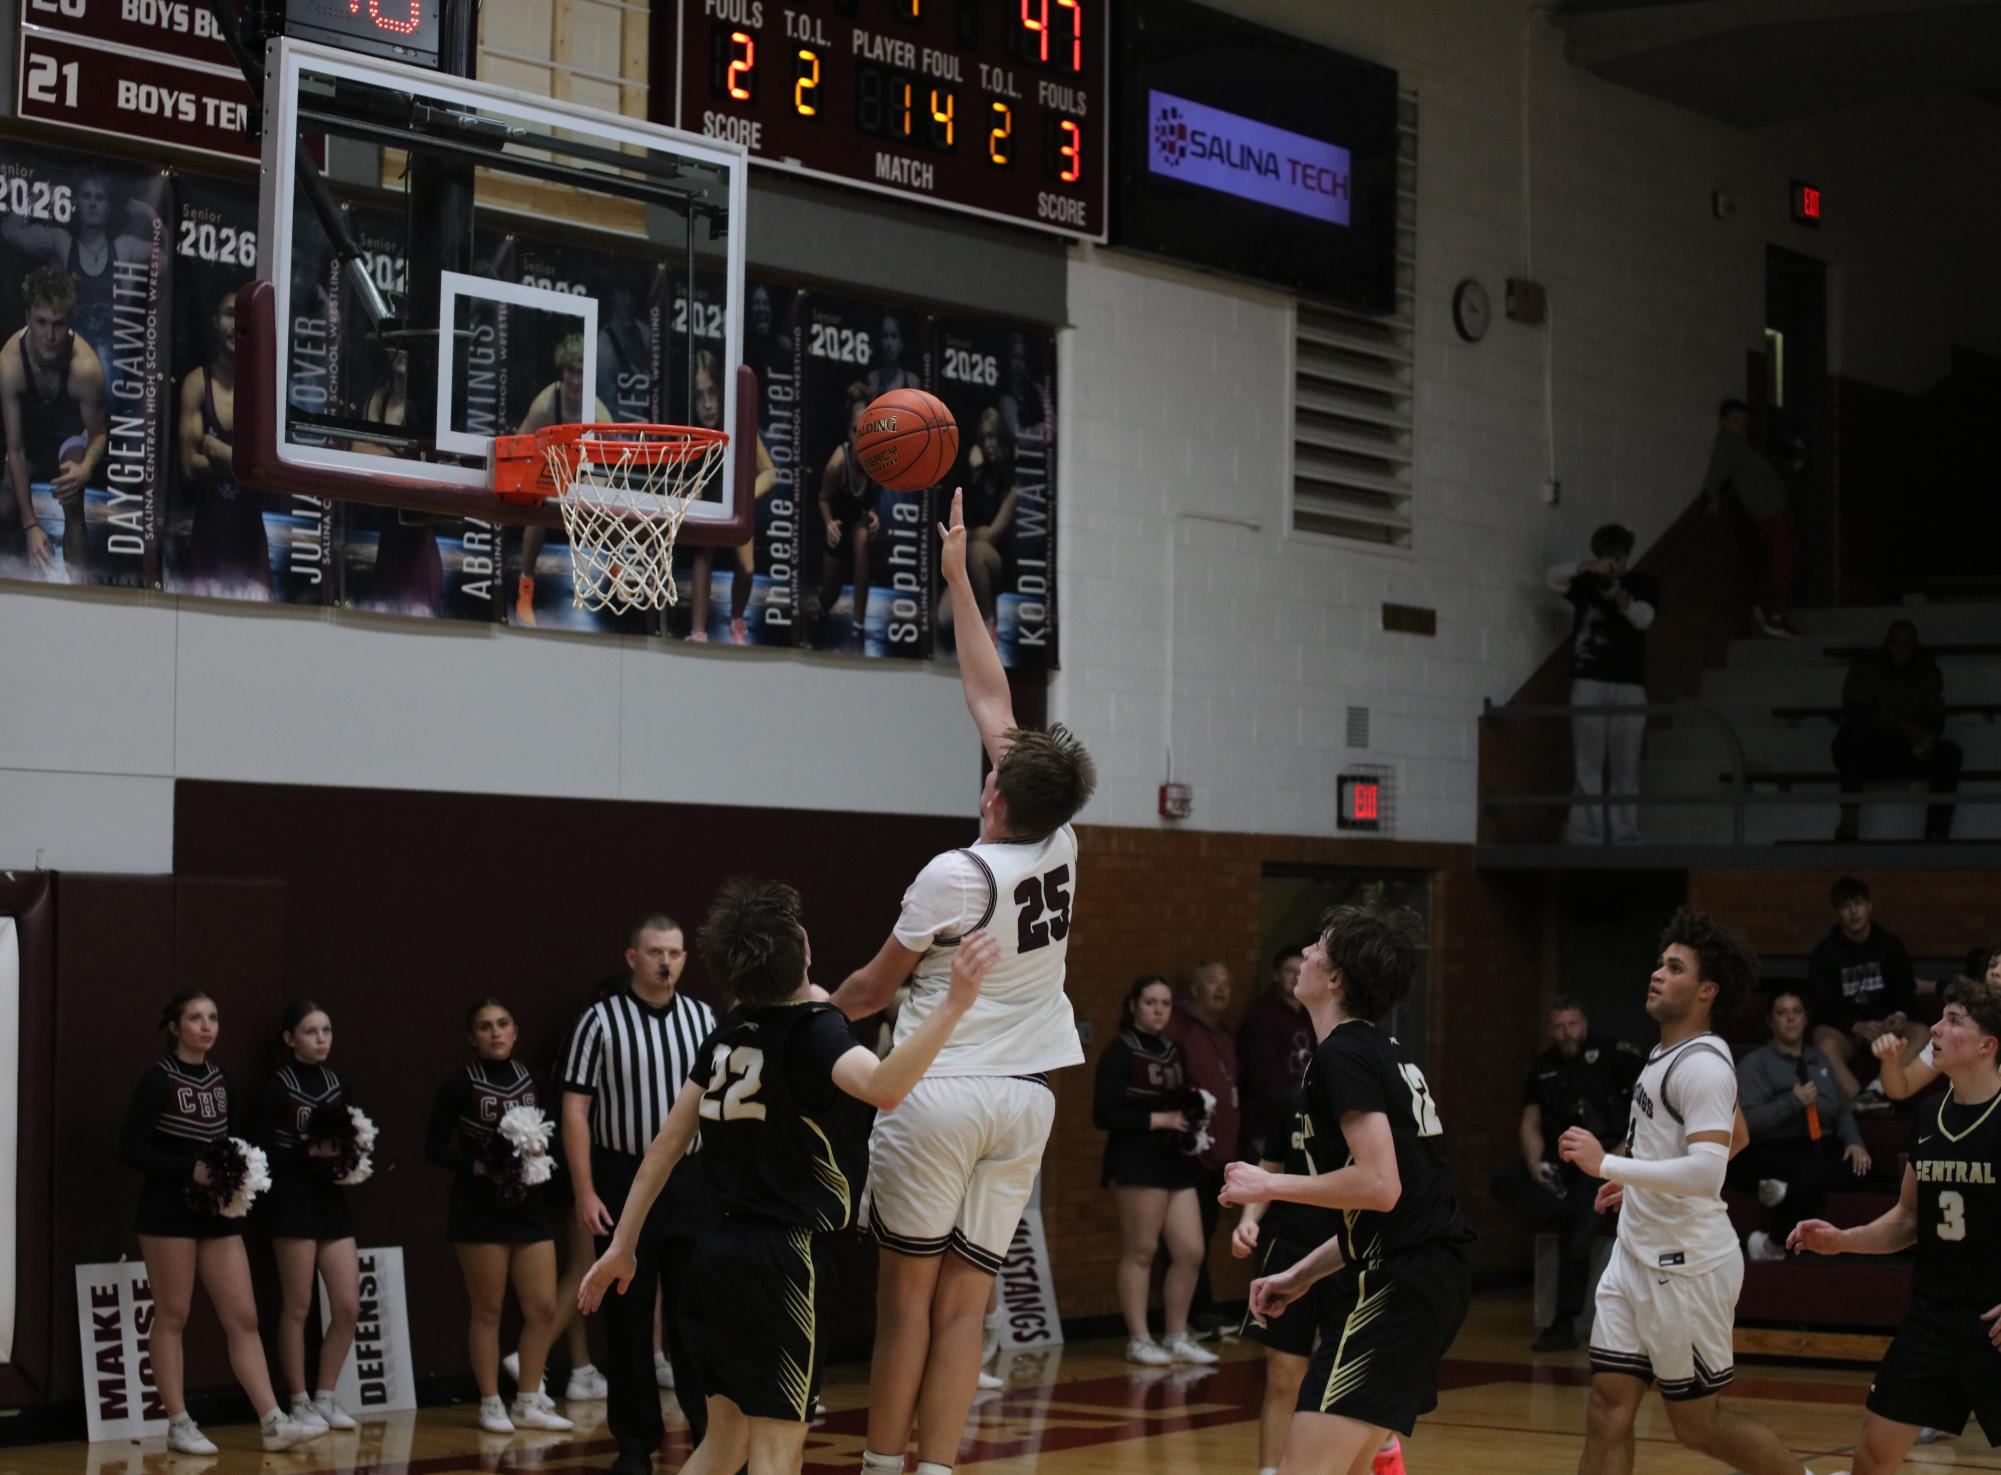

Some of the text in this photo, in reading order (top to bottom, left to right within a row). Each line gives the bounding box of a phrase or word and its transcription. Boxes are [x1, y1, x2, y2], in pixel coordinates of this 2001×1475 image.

[121, 0, 189, 33] BOYS
[704, 0, 764, 29] FOULS
[783, 8, 832, 48] T.O.L.
[727, 31, 755, 101] 2
[794, 48, 821, 117] 2
[853, 27, 964, 84] PLAYER FOUL
[979, 62, 1023, 99] T.O.L.
[28, 53, 79, 108] 21
[117, 79, 197, 123] BOYS
[903, 81, 956, 146] 14
[1037, 79, 1088, 117] FOULS
[703, 109, 763, 150] SCORE
[988, 101, 1012, 165] 2
[1060, 119, 1081, 182] 3
[875, 151, 935, 190] MATCH
[1190, 130, 1349, 200] SALINA TECH
[182, 203, 223, 223] Senior
[1037, 191, 1087, 226] SCORE
[178, 220, 257, 268] 2026
[329, 343, 339, 401] SCHOOL
[810, 323, 871, 365] 2026
[943, 347, 999, 386] 2026
[107, 260, 149, 555] DAYGEN GAWITH
[145, 217, 162, 541] SALINA CENTRAL HIGH SCHOOL WRESTLING
[764, 366, 794, 626] Phoebe Bohrer
[323, 514, 332, 565] SALINA
[887, 502, 920, 644] Sophia
[1017, 558, 1047, 646] KODI
[1014, 864, 1069, 953] 25
[700, 1042, 767, 1122] 22
[1936, 1189, 1967, 1242] 3
[91, 1284, 129, 1421] MAKE
[354, 1255, 388, 1406] DEFENSE
